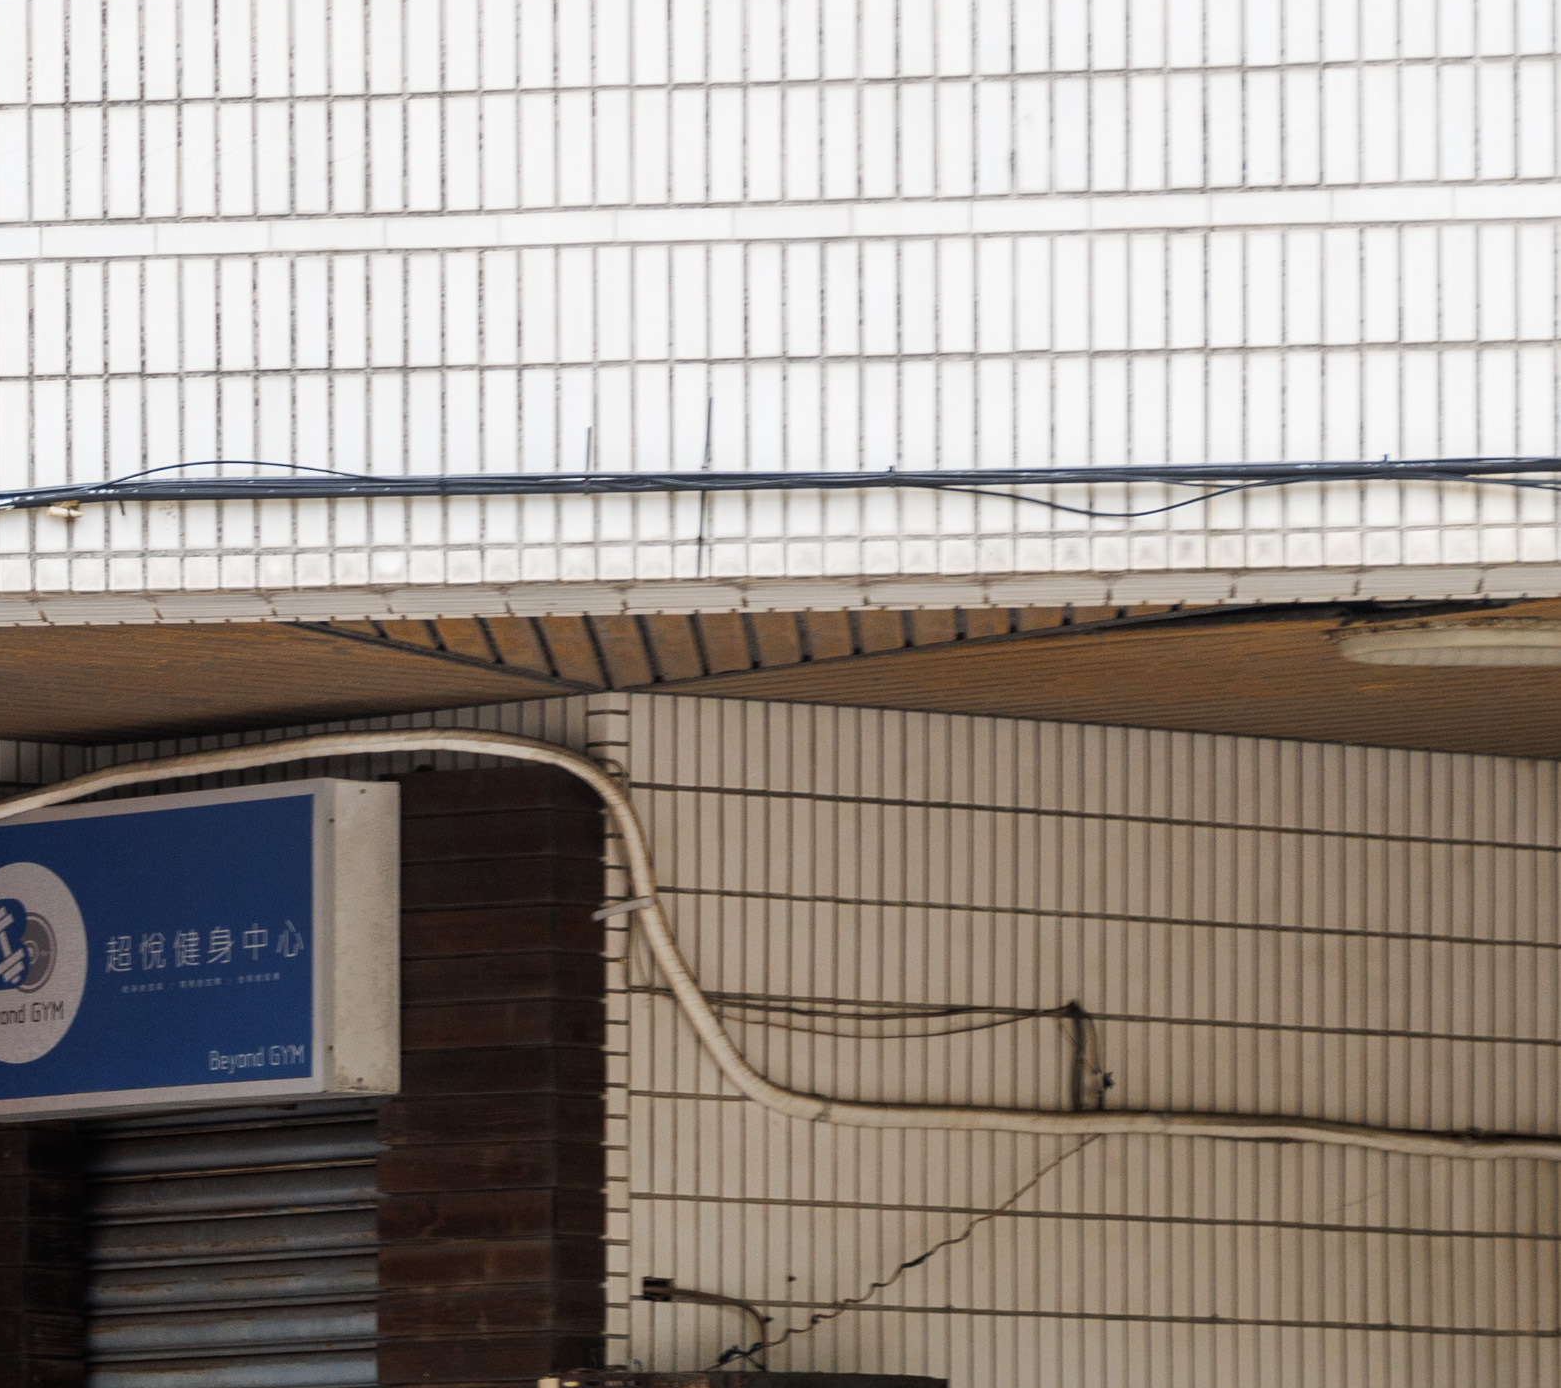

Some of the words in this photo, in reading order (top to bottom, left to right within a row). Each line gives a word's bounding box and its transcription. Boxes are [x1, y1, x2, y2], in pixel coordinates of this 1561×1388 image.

[31, 1000, 65, 1023] GYM
[209, 1047, 265, 1075] Beyond
[269, 1044, 306, 1067] GYM
